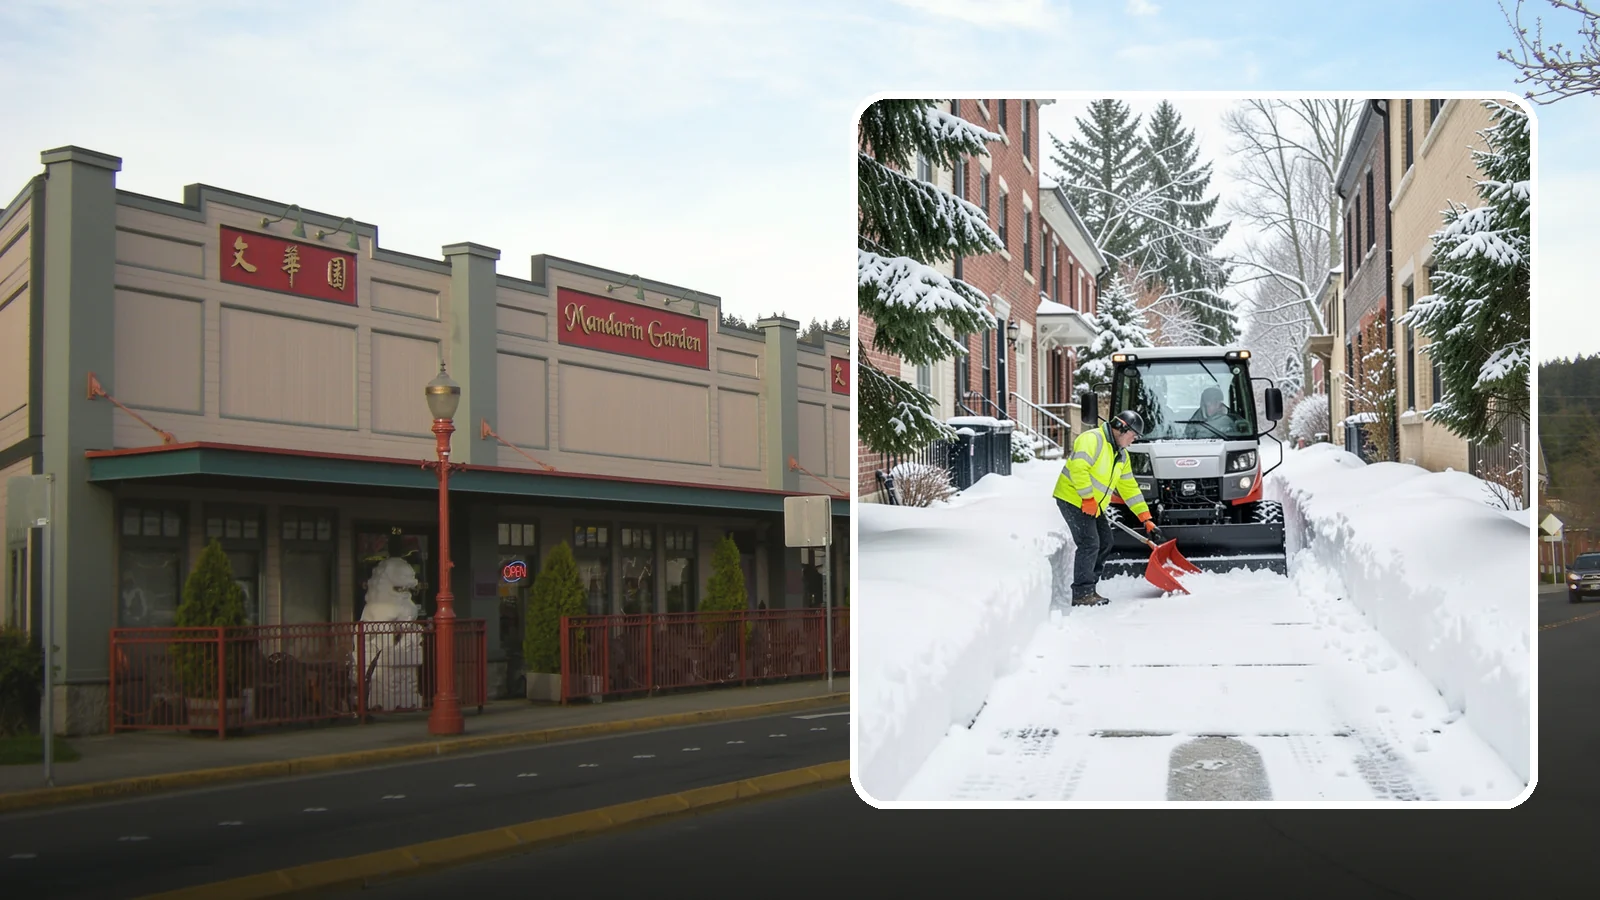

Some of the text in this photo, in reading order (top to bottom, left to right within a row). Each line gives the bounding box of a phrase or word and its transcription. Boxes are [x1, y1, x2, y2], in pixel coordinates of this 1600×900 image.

[231, 236, 347, 291] 文華園
[564, 302, 701, 352] Mandarin Garden
[503, 565, 527, 578] OPEN
